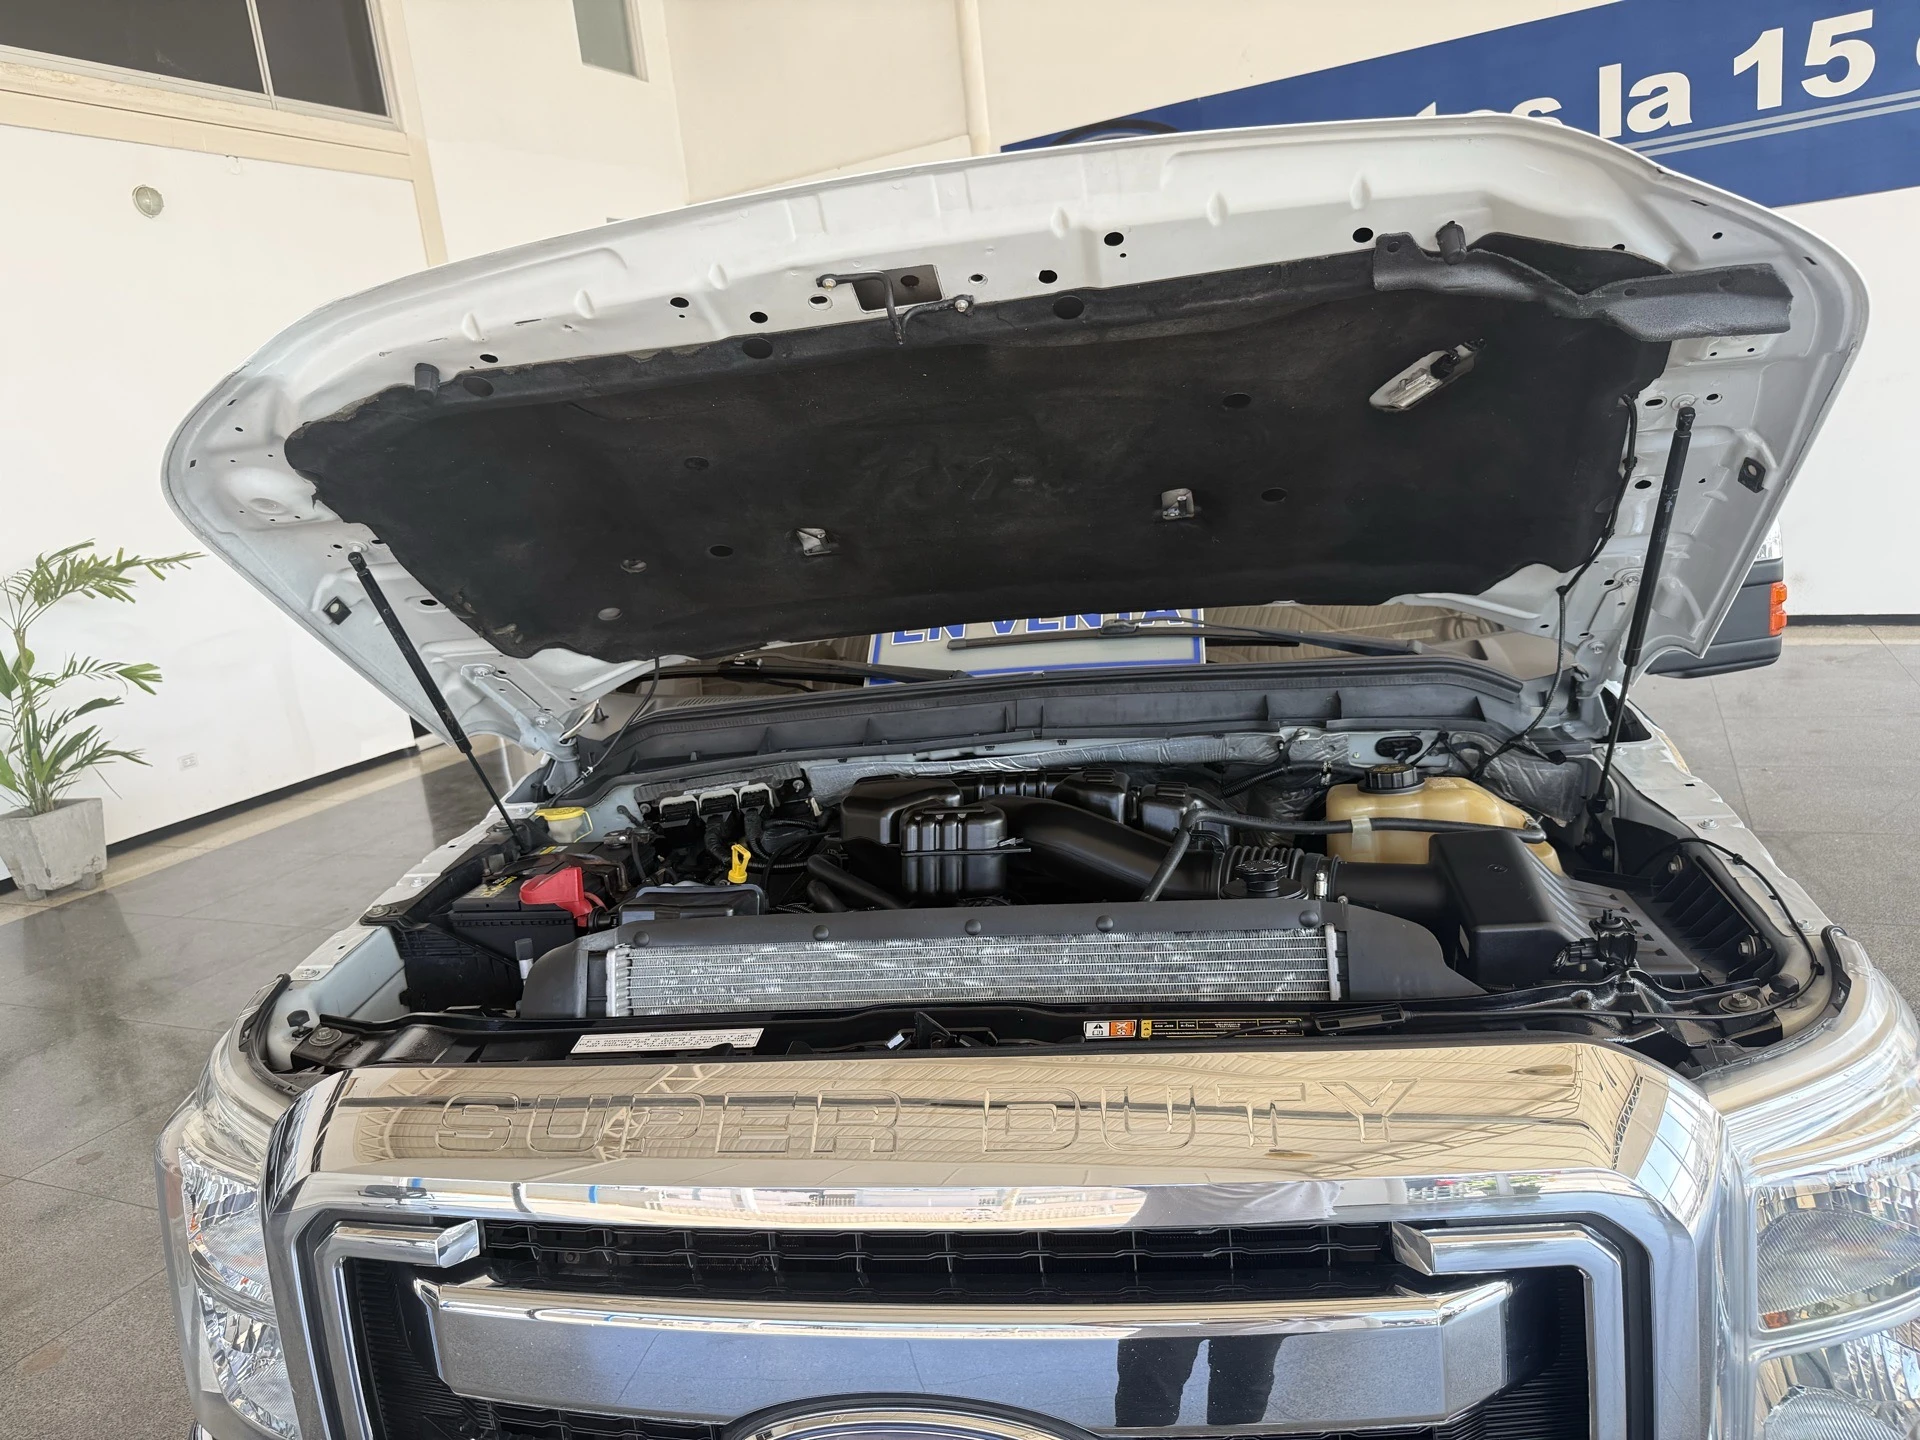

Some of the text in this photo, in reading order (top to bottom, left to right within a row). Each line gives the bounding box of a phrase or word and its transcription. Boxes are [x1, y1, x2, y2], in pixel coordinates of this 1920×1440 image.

[1598, 9, 1876, 138] la 15
[435, 1077, 1421, 1153] SUPER DUTY
